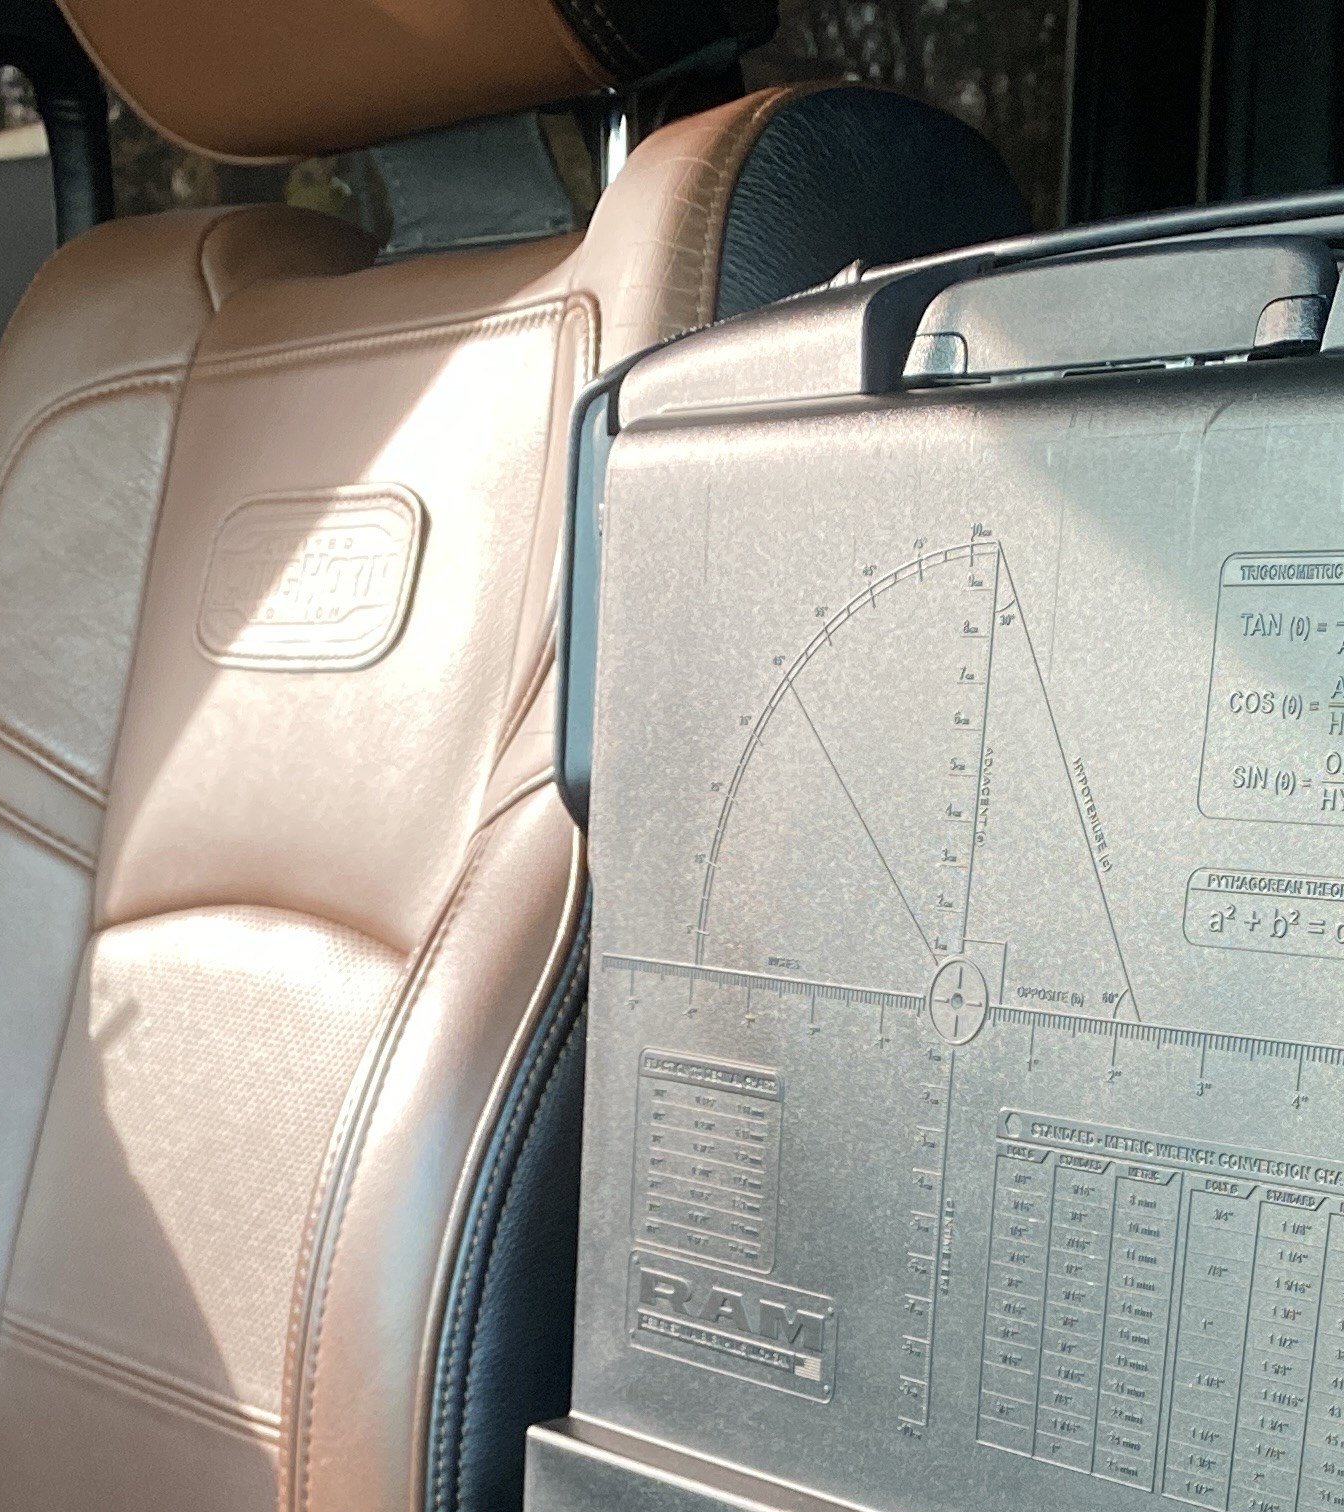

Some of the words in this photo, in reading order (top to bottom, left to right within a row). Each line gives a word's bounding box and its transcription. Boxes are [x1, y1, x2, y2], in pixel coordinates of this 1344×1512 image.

[1240, 563, 1344, 581] TRIGONOMETRIC
[1240, 613, 1283, 637] TAN
[1229, 691, 1276, 715] COS
[1232, 765, 1269, 789] SIN
[1207, 873, 1303, 895] PYTHAGOREAN
[1016, 986, 1068, 1003] OPPOSITE
[1030, 1121, 1095, 1145] STANDARD
[1103, 1133, 1155, 1155] METRIC
[1156, 1142, 1215, 1165] WRENCH
[1217, 1153, 1312, 1182] CONVERSION
[1265, 1189, 1317, 1208] STANDARD
[639, 1267, 825, 1352] RAM
